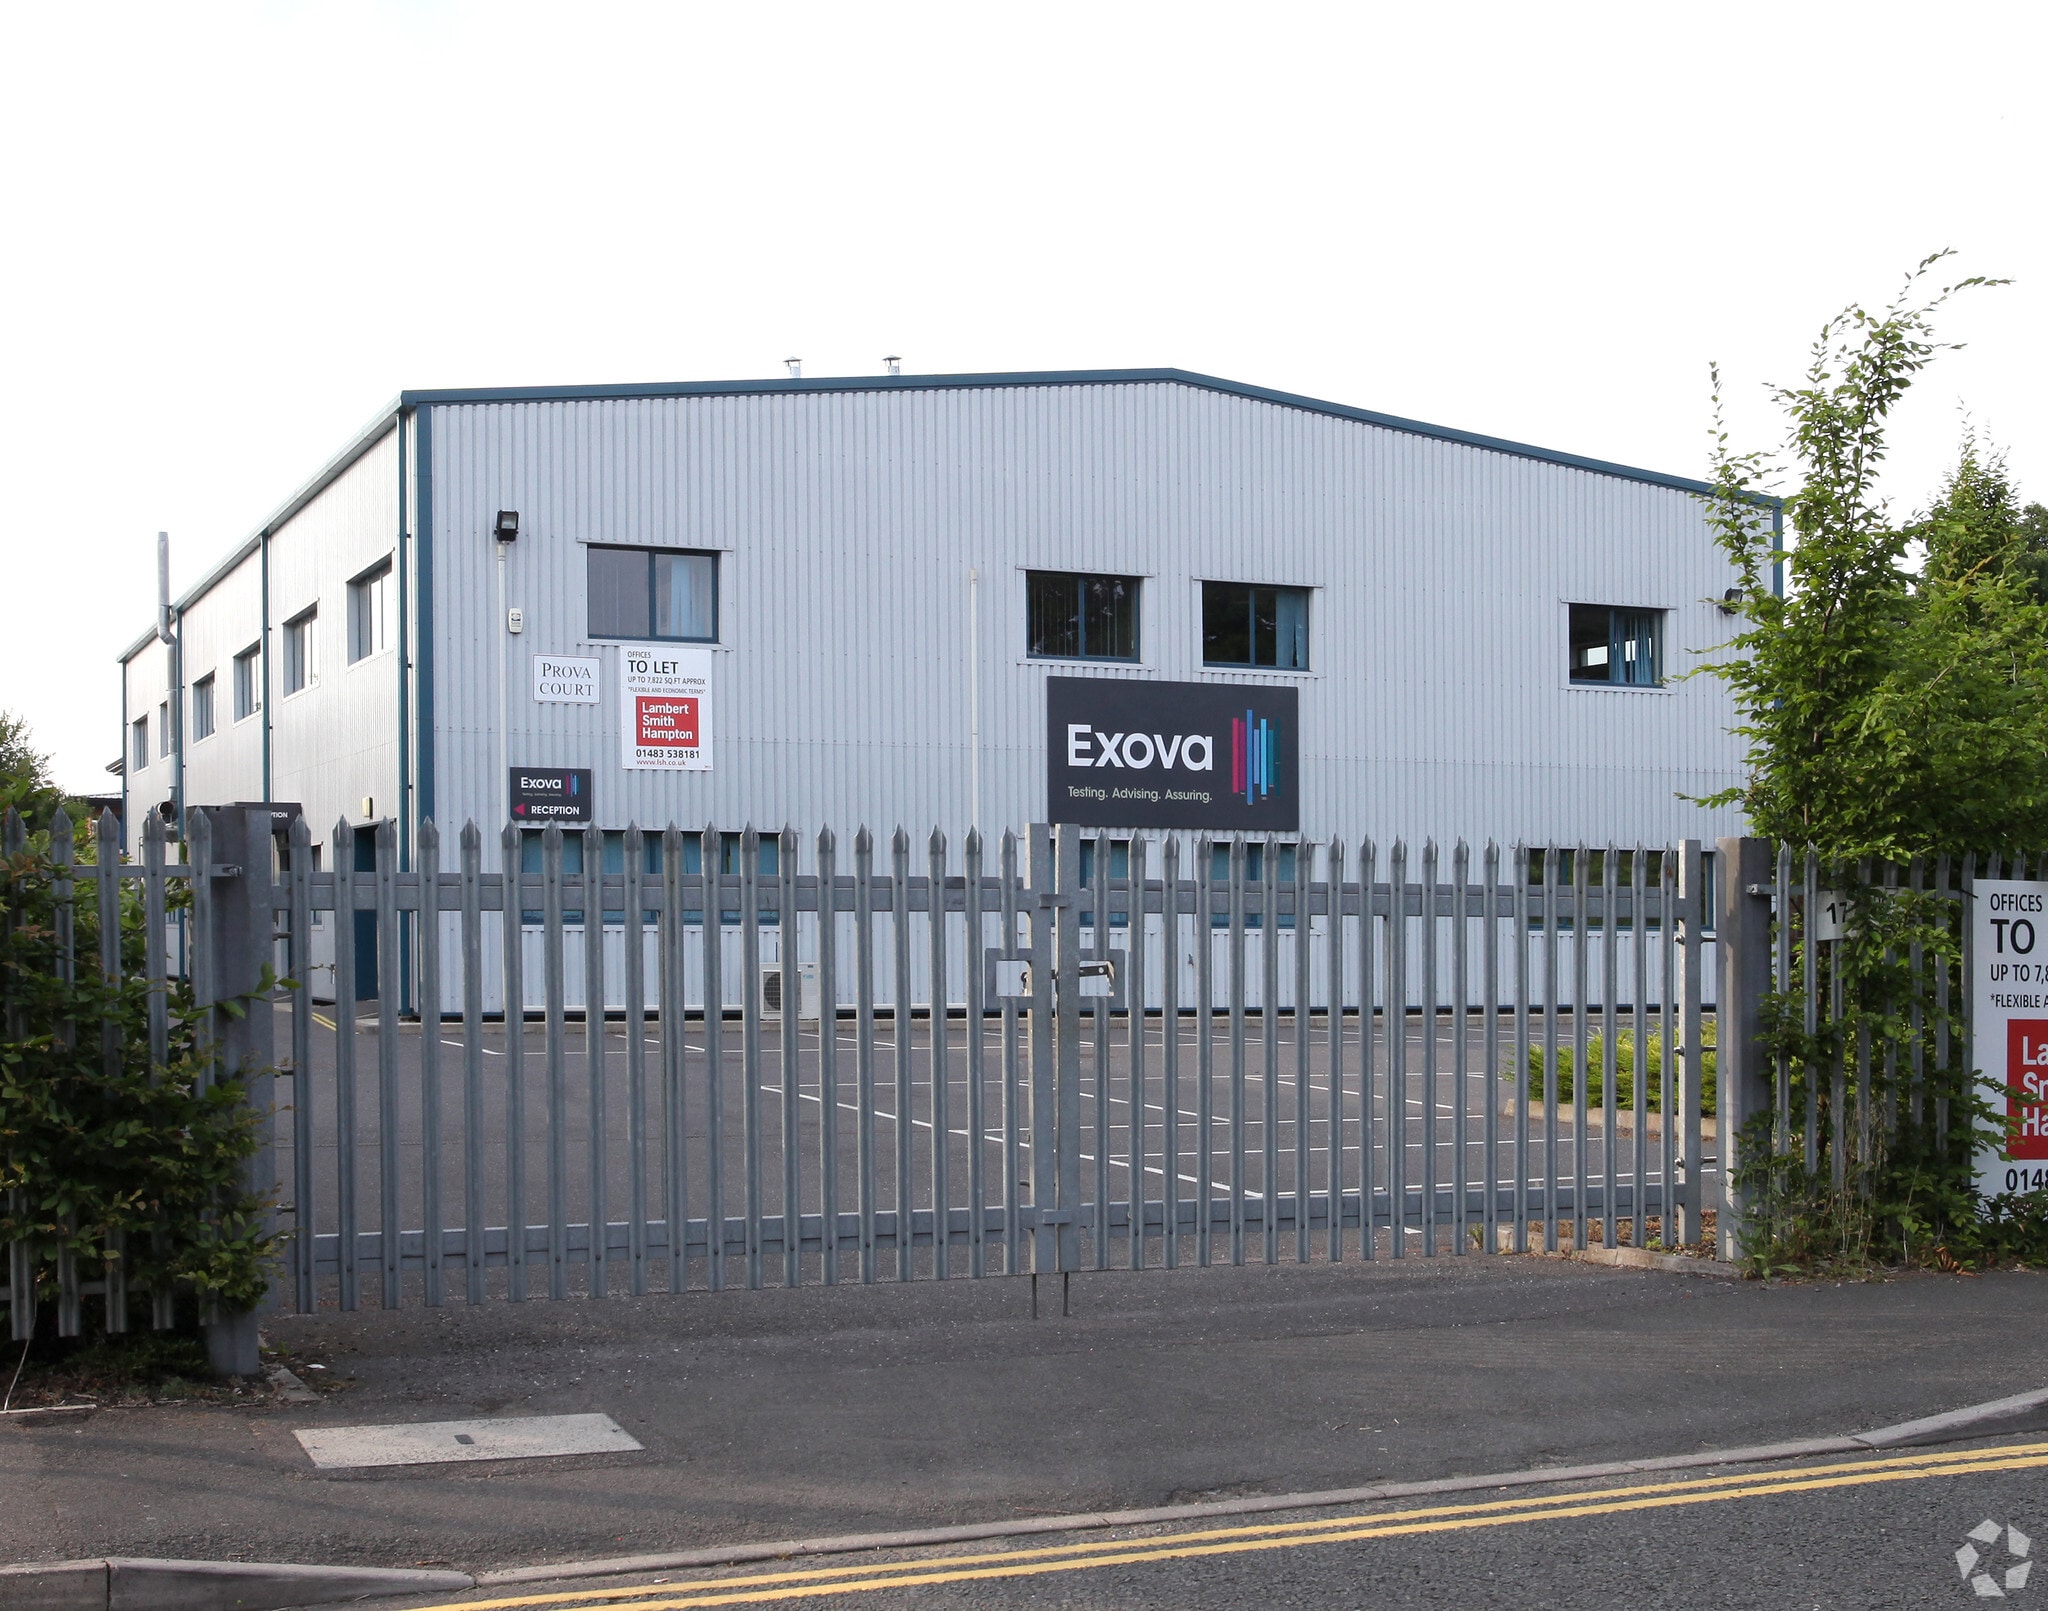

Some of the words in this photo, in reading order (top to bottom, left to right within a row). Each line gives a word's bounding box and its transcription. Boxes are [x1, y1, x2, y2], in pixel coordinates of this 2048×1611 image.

[542, 662, 592, 680] PROVA
[627, 660, 648, 673] TO
[654, 661, 679, 674] LET
[539, 682, 595, 697] COURT
[642, 701, 689, 714] Lambert
[642, 714, 675, 726] Smith
[642, 727, 693, 741] Hampton
[636, 749, 664, 758] 01483
[667, 749, 700, 759] 538181
[1067, 723, 1213, 771] Exova
[520, 777, 562, 789] Exova
[1068, 785, 1109, 801] Testing.
[1112, 787, 1161, 803] Advising.
[1165, 788, 1213, 804] Assuring.
[531, 805, 580, 815] RECEPTION
[1990, 893, 2043, 912] OFFICES
[1990, 918, 2035, 954] TO
[1990, 964, 2008, 981] UP
[2012, 964, 2030, 982] TO
